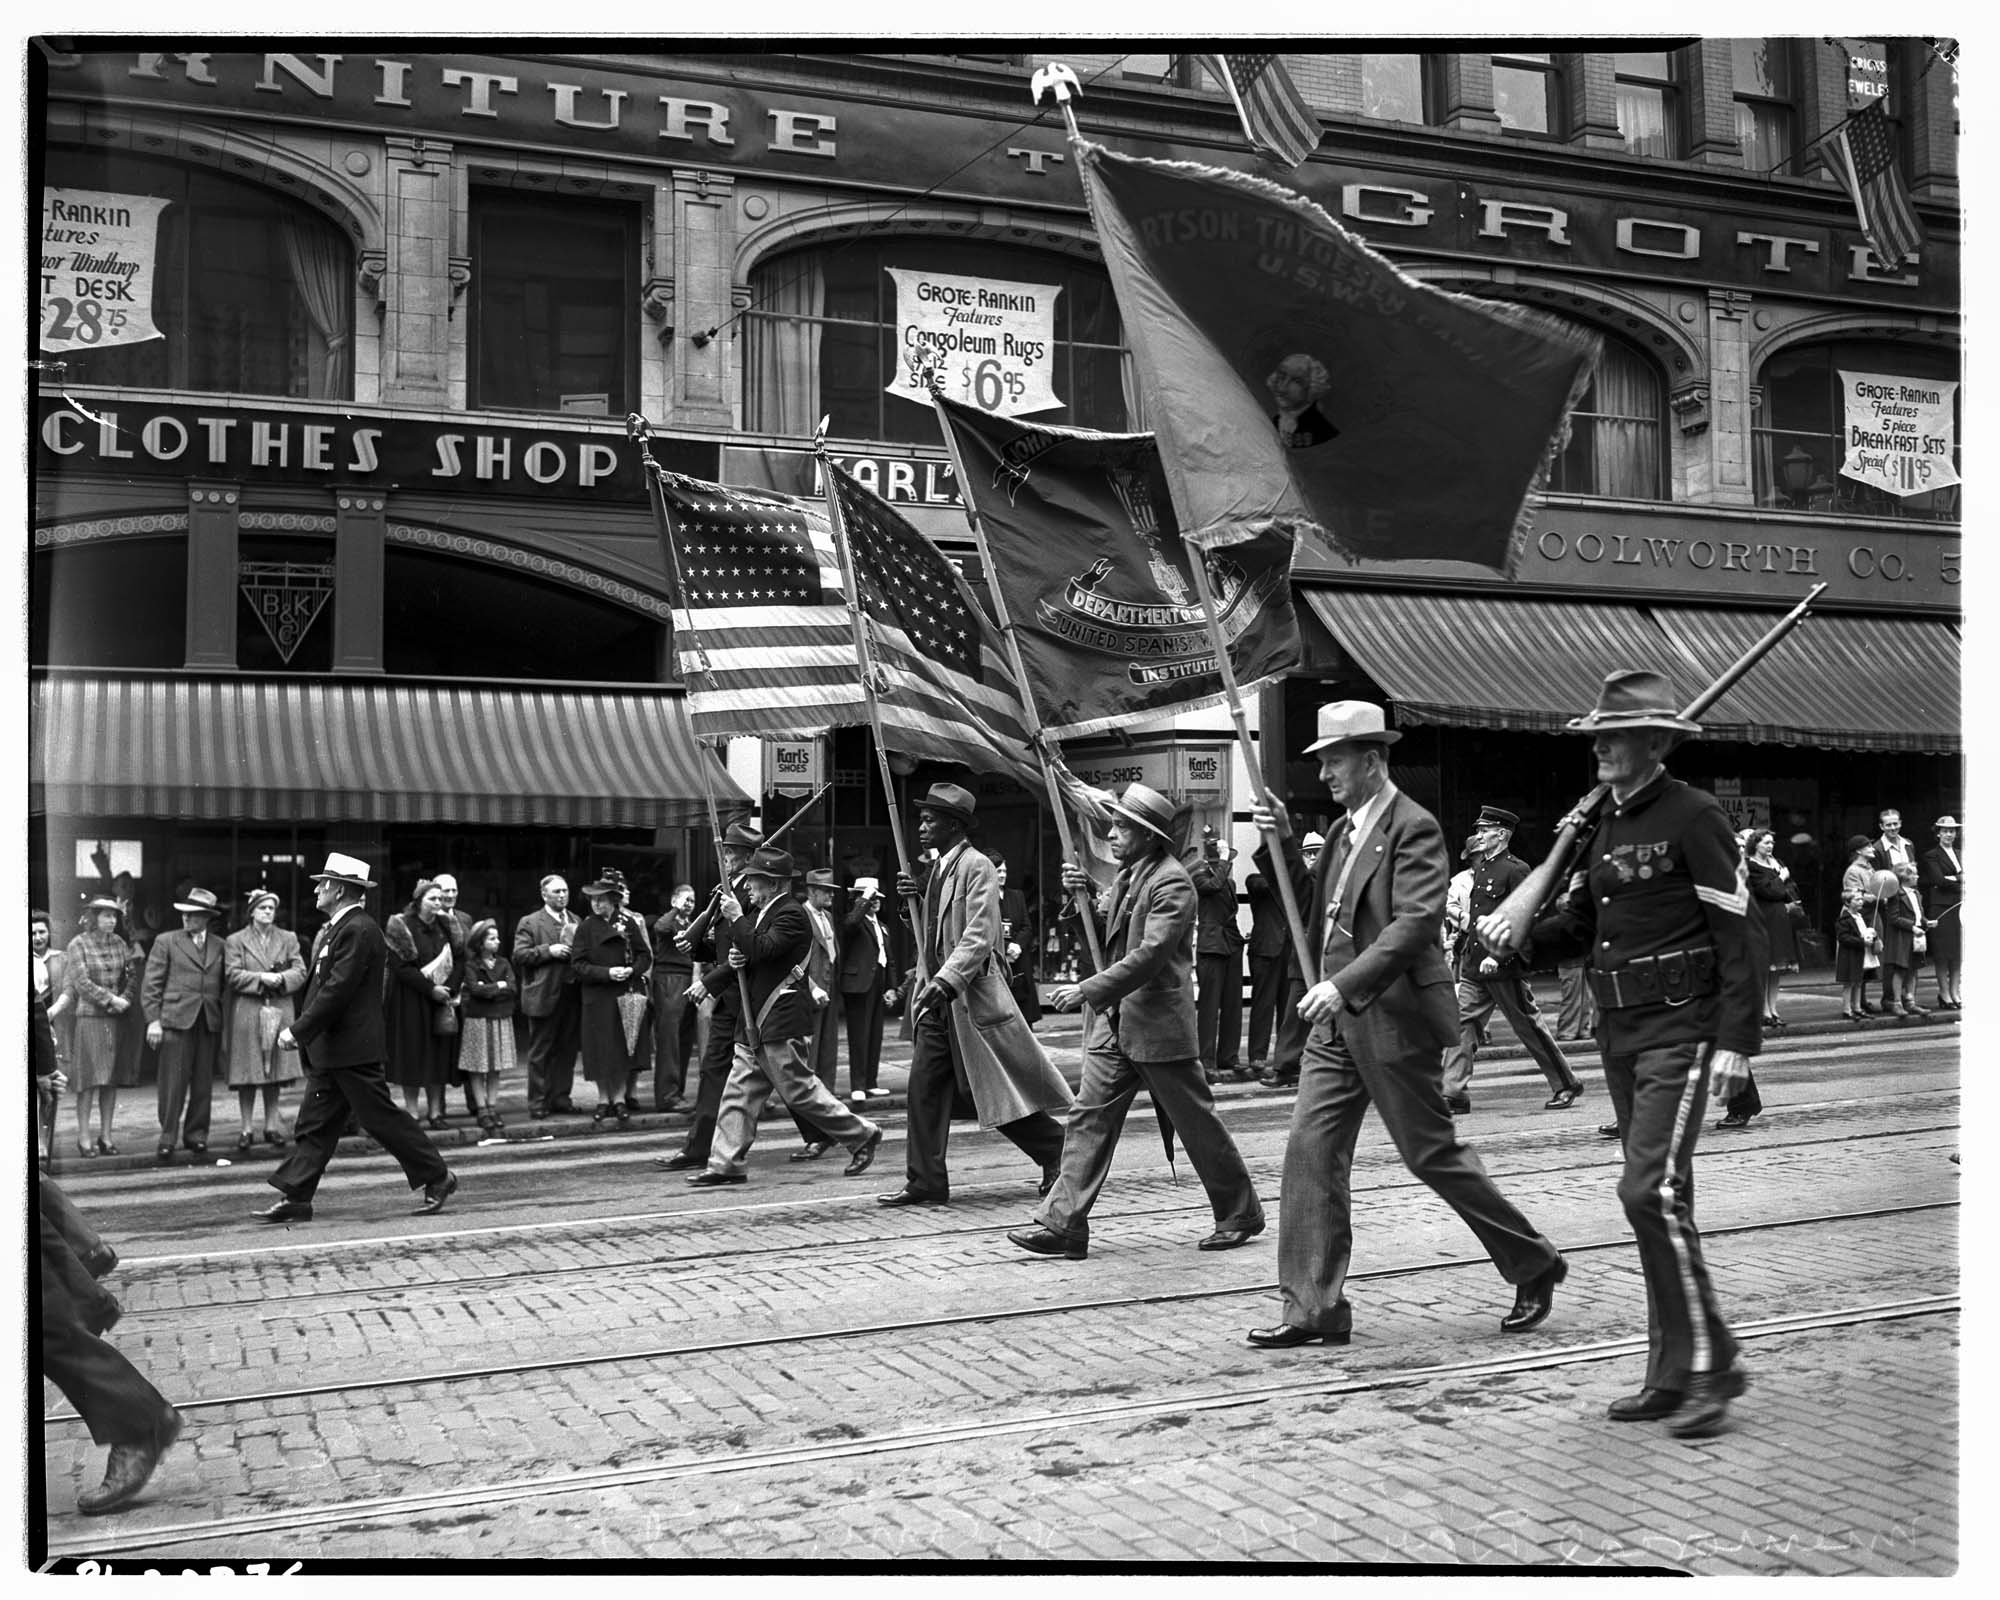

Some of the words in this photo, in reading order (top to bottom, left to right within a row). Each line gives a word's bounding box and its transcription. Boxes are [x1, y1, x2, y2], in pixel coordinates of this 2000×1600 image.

[48, 53, 837, 159] RNITURE
[1342, 184, 1920, 287] GROTE
[43, 222, 100, 245] tures
[70, 251, 140, 282] Winthrop
[75, 277, 135, 302] DESK
[917, 281, 1036, 313] GROTE-RANKIN
[943, 306, 1004, 327] Features
[905, 324, 996, 358] Congoleum
[1003, 332, 1045, 366] Rugs
[1856, 381, 1940, 405] GROTE-RANKIN
[1871, 400, 1919, 418] Features
[1881, 418, 1890, 431] 5
[1891, 421, 1917, 434] piece
[42, 411, 382, 474] CLOTHES
[431, 434, 617, 487] SHOP
[1851, 425, 1919, 452] BREAKFAST
[1922, 434, 1946, 455] SETS
[1853, 449, 1890, 478] Special
[814, 456, 965, 506] ARL'
[1538, 531, 1819, 576] OOLWORTH
[1073, 589, 1180, 625] DEPARTMENT
[1059, 616, 1117, 649] UNITED
[777, 747, 809, 764] Karl's
[778, 763, 807, 773] SHOES
[1188, 756, 1217, 771] Karl's
[1112, 766, 1143, 783] SHOES
[1190, 771, 1216, 780] SHOES
